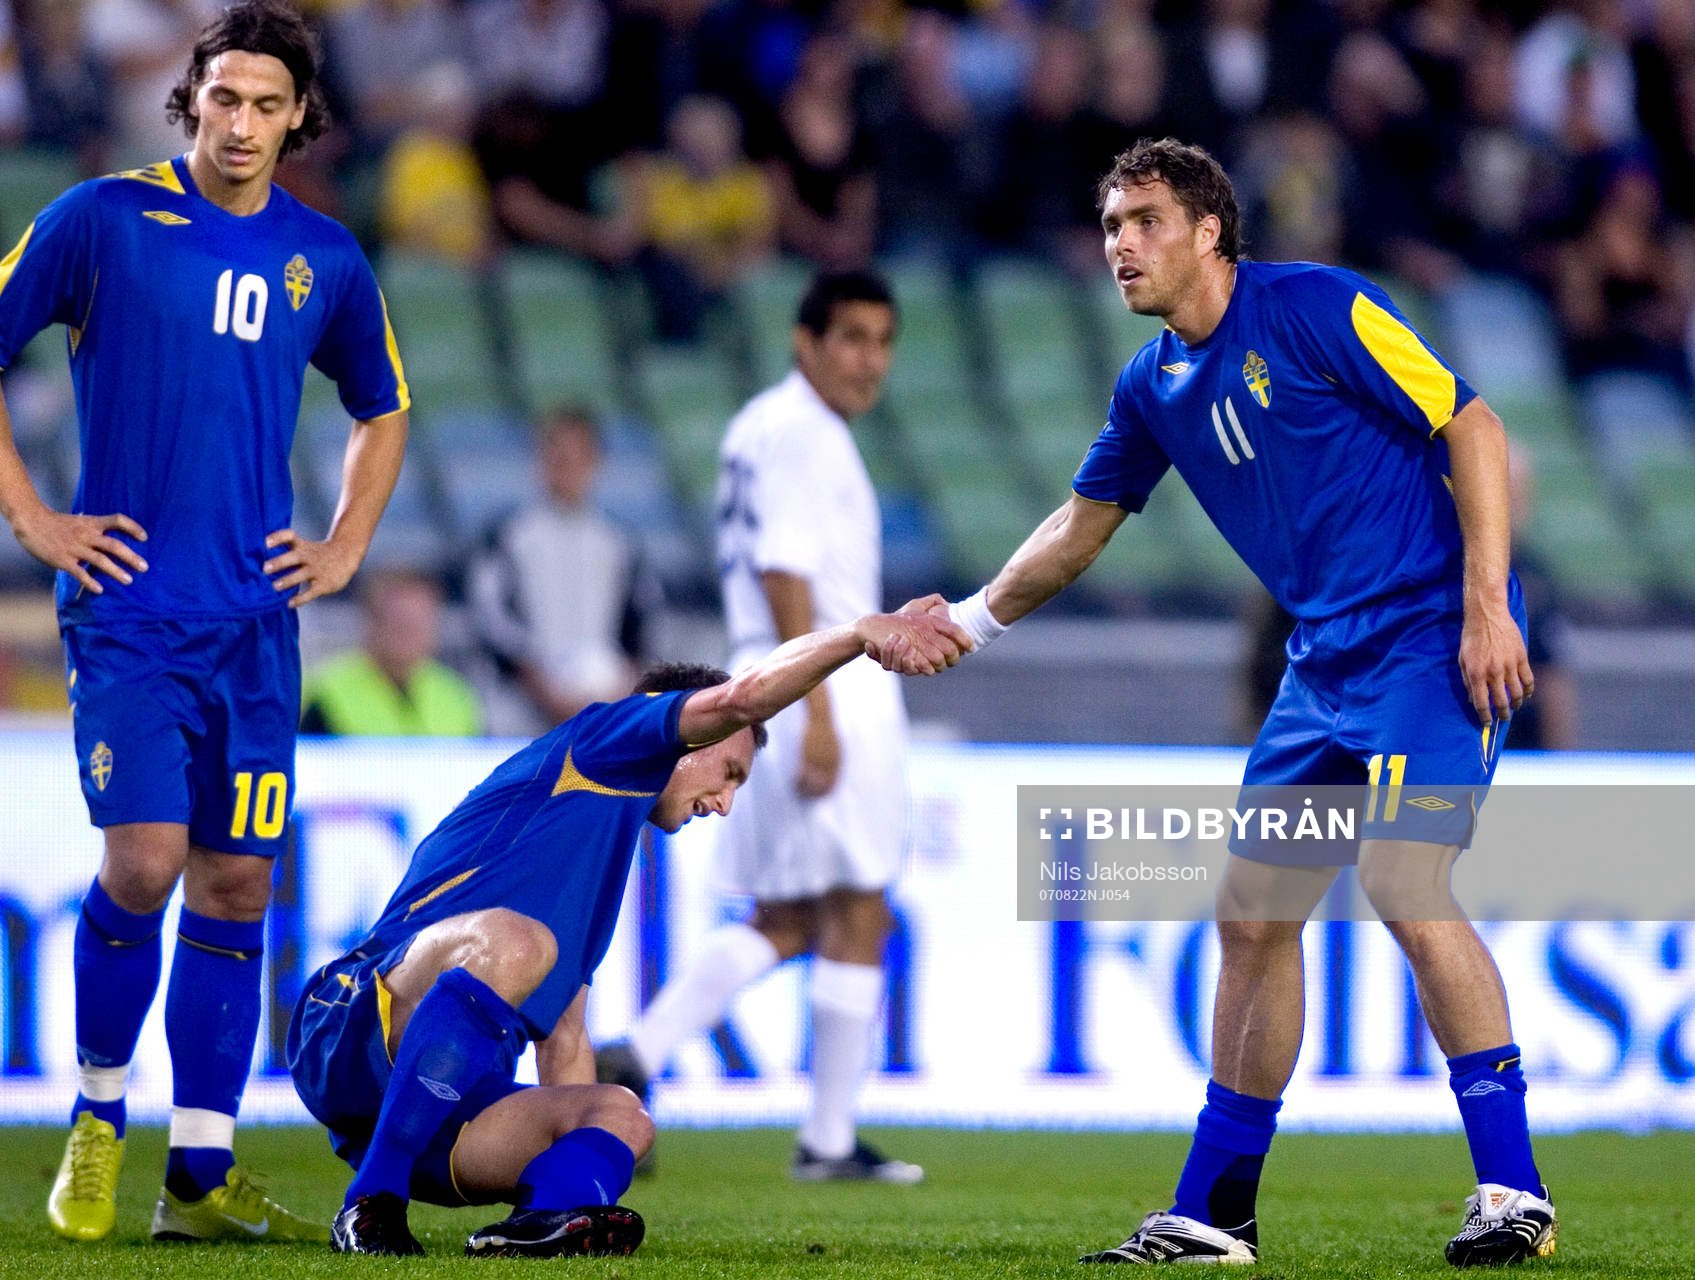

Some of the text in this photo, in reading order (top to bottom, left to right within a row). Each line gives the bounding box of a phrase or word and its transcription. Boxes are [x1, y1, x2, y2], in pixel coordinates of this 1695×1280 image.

[213, 268, 269, 343] 10
[1211, 396, 1255, 465] 11
[231, 772, 287, 838] 10
[1365, 754, 1407, 822] 11
